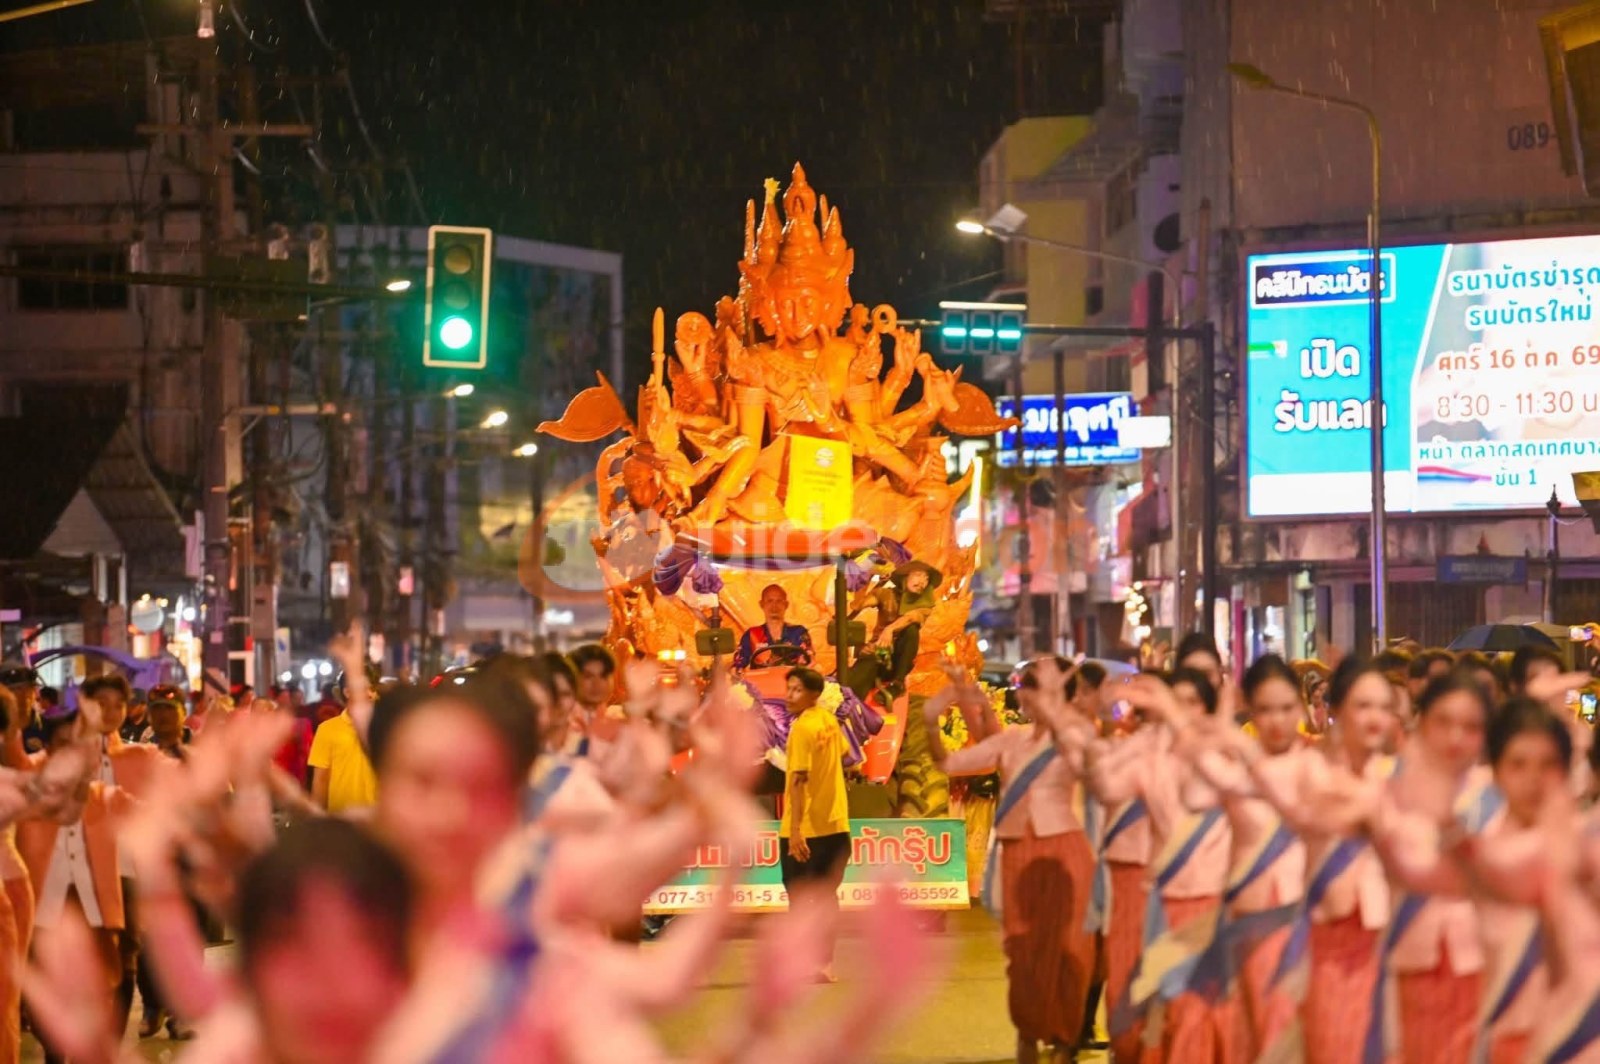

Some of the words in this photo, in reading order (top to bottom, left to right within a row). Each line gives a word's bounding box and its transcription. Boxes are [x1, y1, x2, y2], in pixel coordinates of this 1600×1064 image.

[1469, 294, 1592, 326] ธนบัตรใหม่
[1300, 338, 1360, 379] เปิด
[1438, 346, 1481, 381] ศุกร์
[1490, 349, 1515, 369] 16
[1572, 345, 1600, 365] 69
[1515, 390, 1574, 415] 11:30
[1529, 468, 1537, 485] 1
